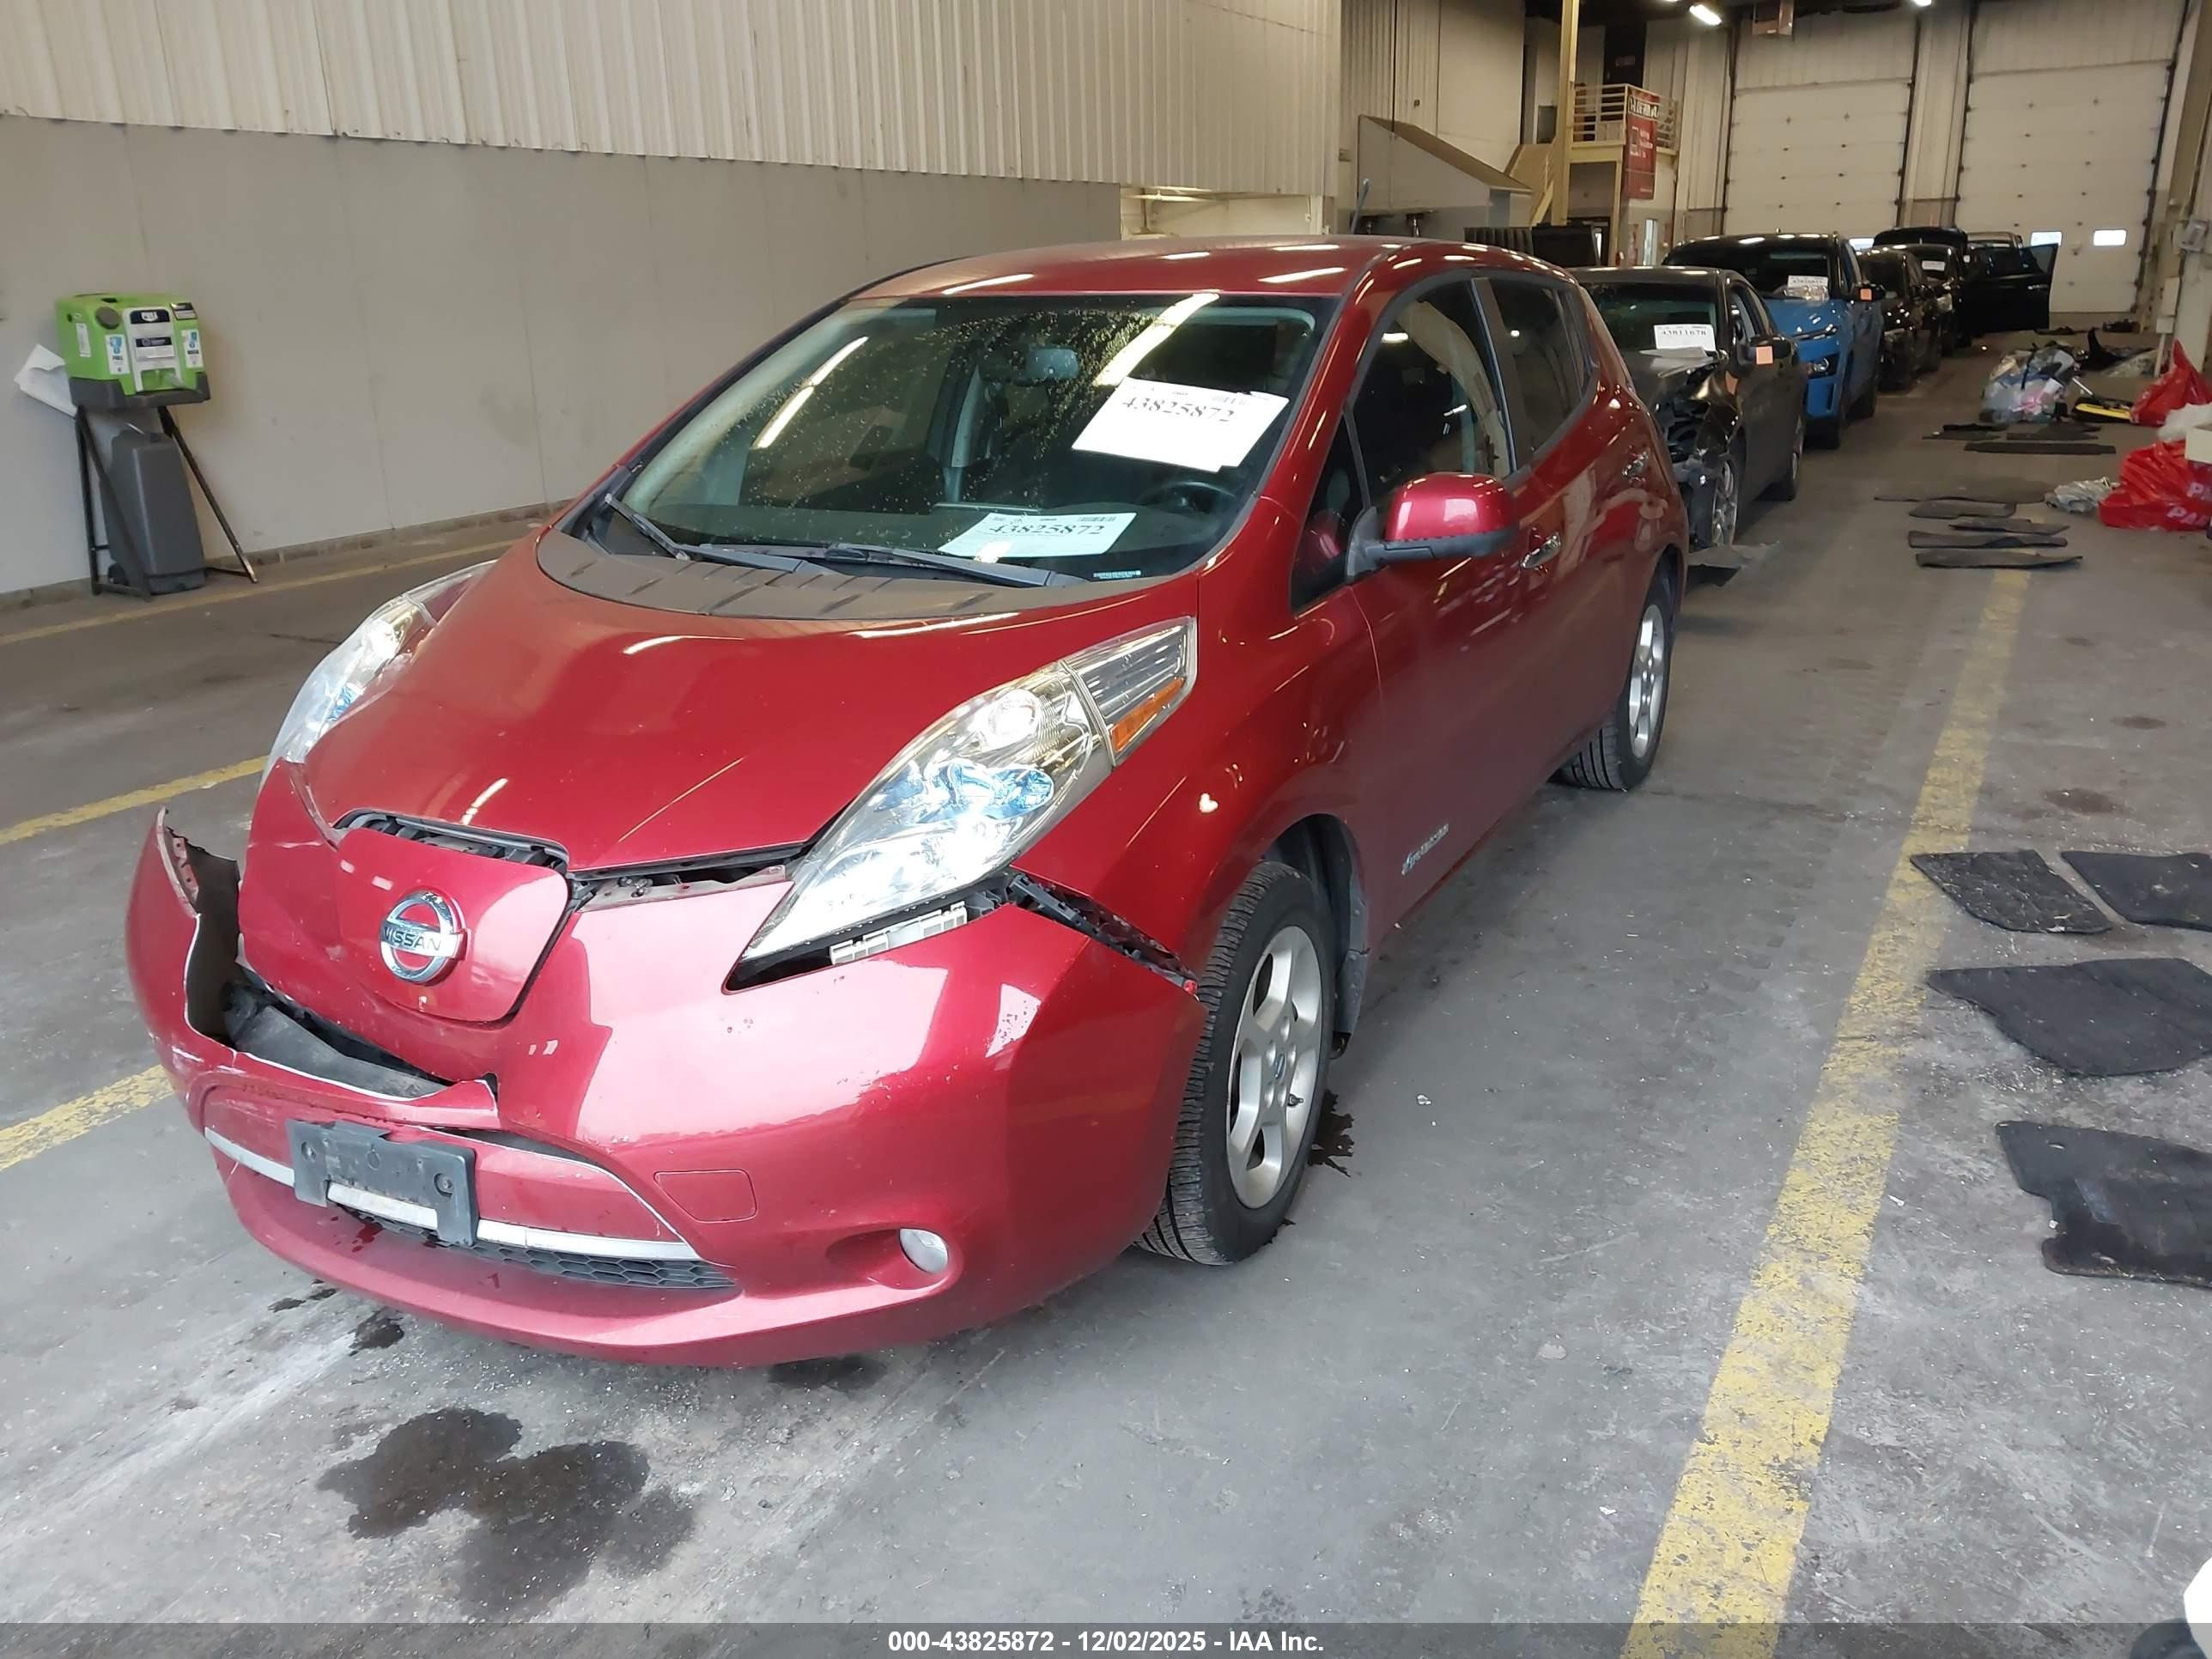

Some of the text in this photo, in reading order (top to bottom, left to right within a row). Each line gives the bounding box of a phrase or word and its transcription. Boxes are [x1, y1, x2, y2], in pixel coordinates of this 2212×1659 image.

[1123, 397, 1235, 422] 43825872
[988, 524, 1105, 535] 43825872
[384, 926, 441, 951] NISSAN
